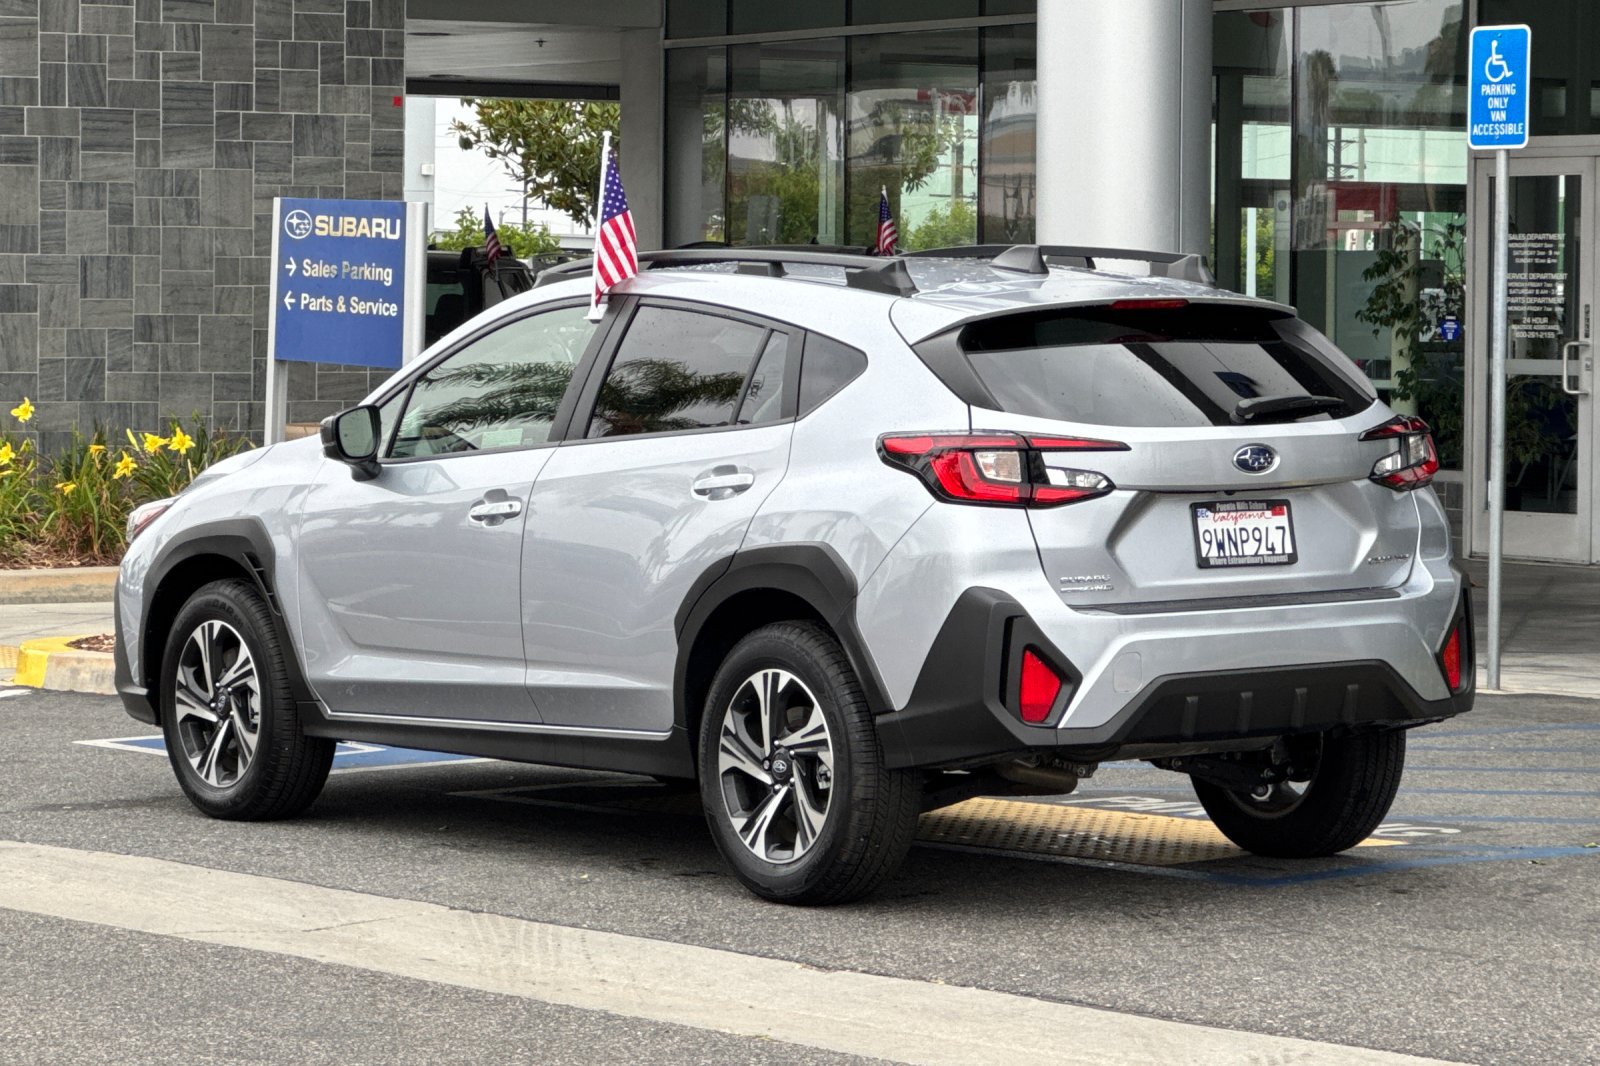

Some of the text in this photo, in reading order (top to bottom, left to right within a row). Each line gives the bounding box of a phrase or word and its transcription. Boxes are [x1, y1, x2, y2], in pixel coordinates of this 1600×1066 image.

[1481, 83, 1516, 96] PARKING
[1487, 97, 1508, 109] ONLY
[1490, 110, 1506, 122] VAN
[1472, 123, 1524, 136] ACCESSIBLE
[314, 215, 401, 240] SUBARU
[302, 258, 392, 286] Sales Parking
[300, 293, 398, 317] Parts & Service
[1197, 509, 1209, 518] DEC
[1212, 510, 1271, 525] California
[1202, 526, 1286, 557] 9WNP947
